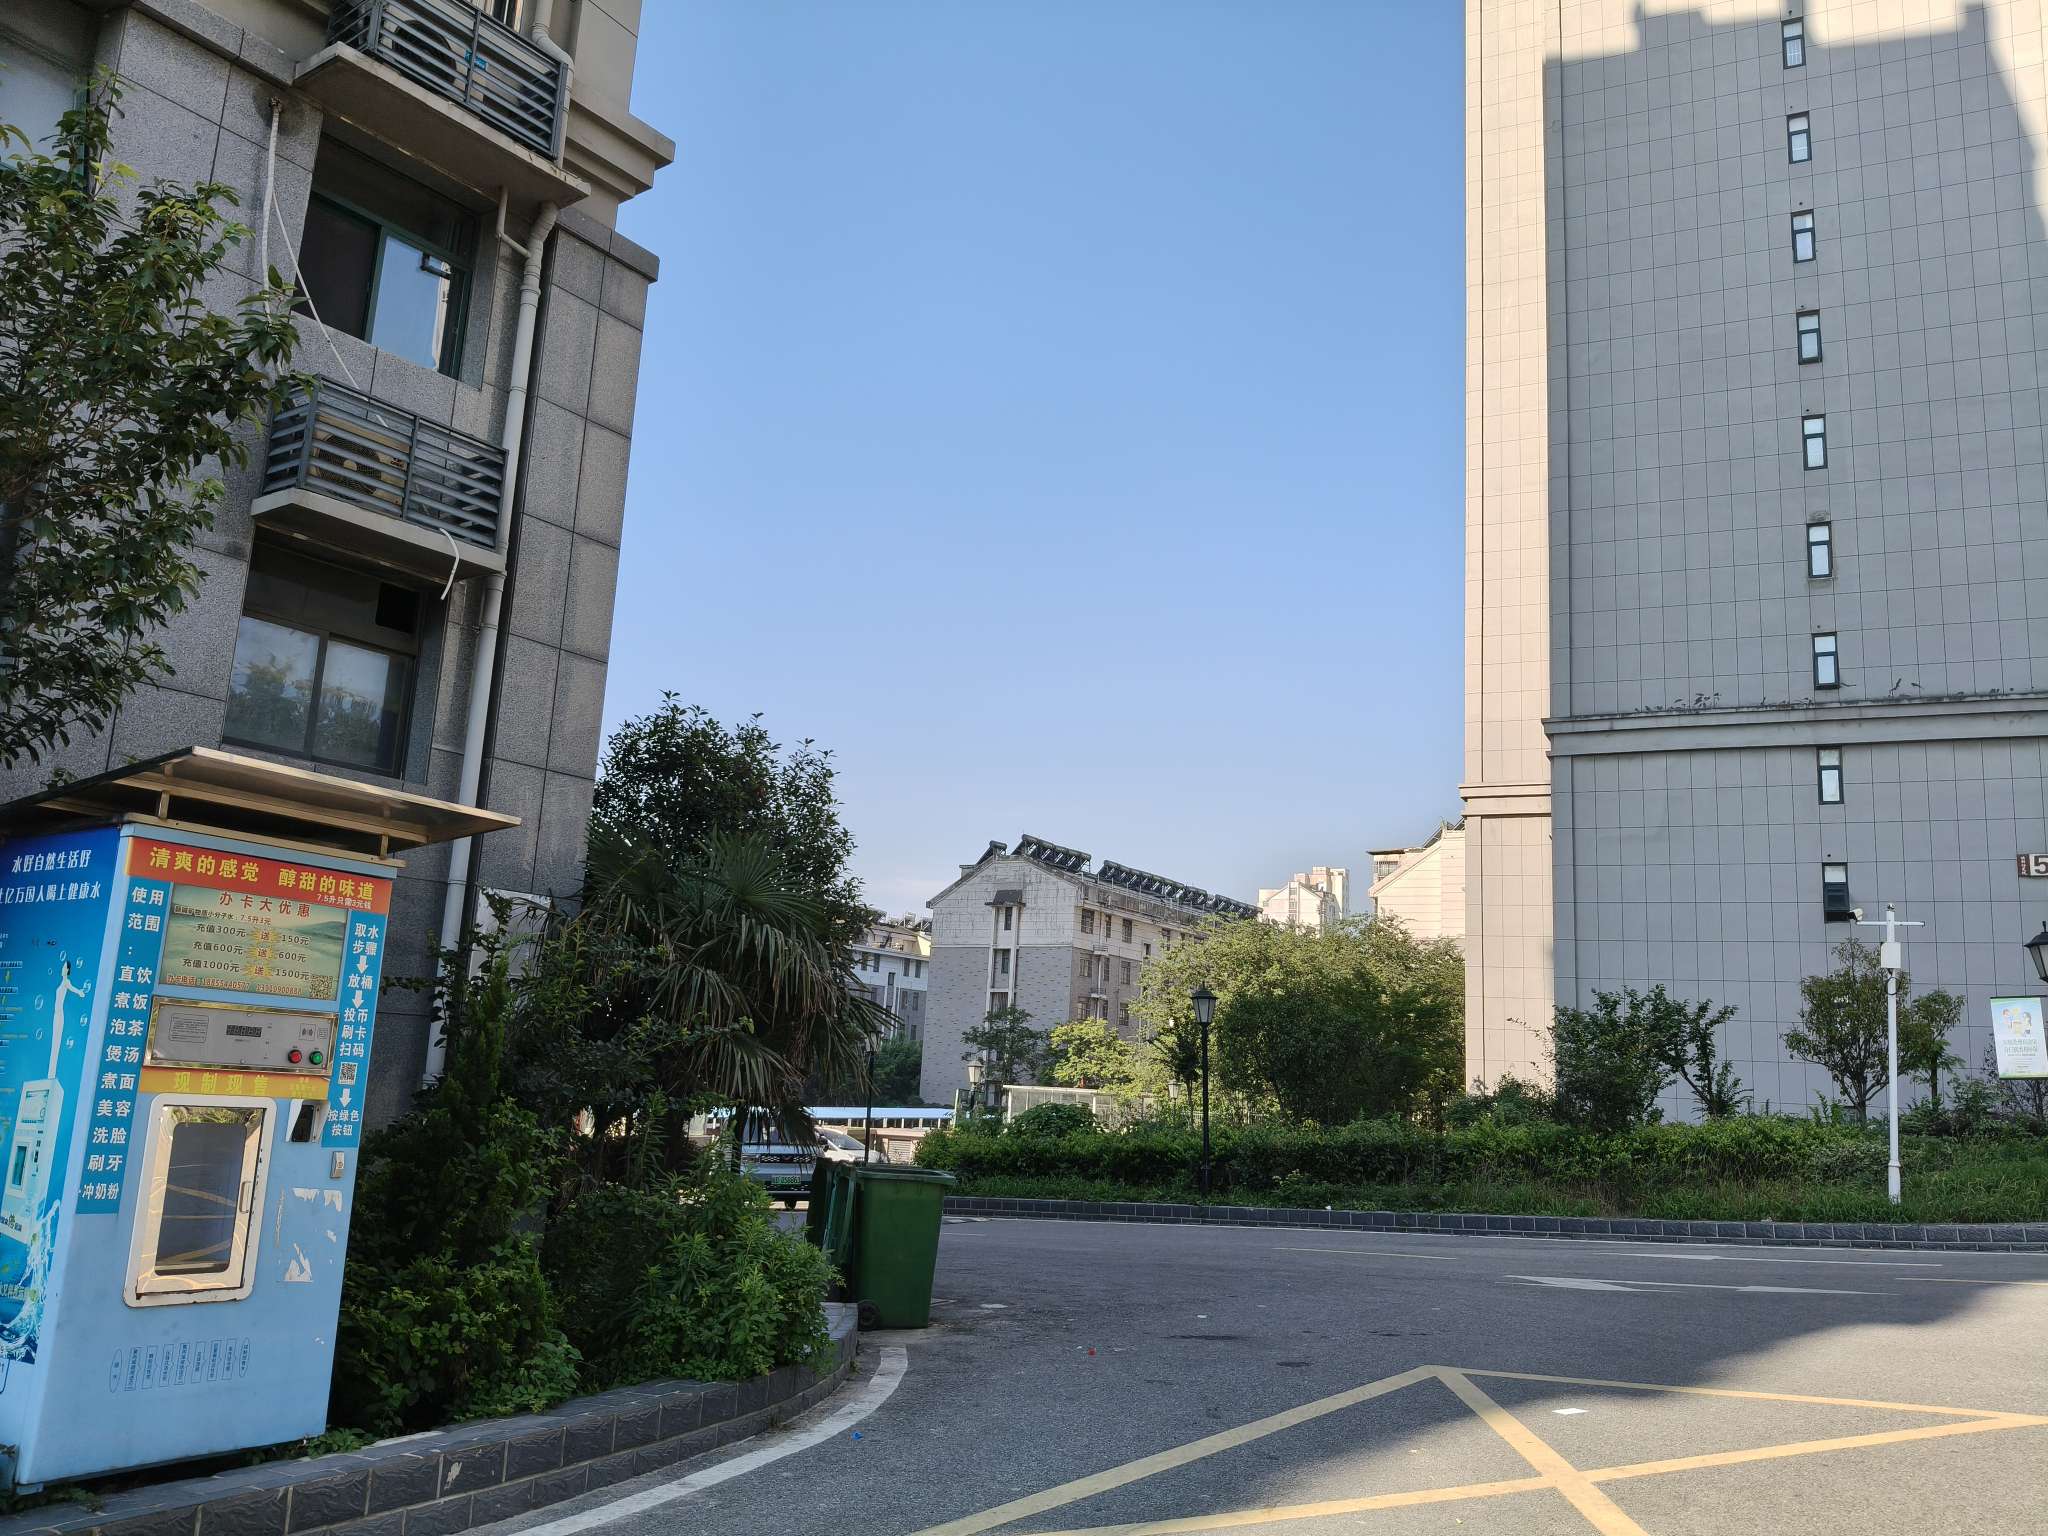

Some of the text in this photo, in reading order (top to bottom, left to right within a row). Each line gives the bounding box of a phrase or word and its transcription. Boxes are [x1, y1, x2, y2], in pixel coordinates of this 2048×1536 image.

[12, 849, 91, 872] 水好自然生活好
[150, 846, 375, 901] 清爽的感觉 醇甜的味道
[132, 886, 164, 906] 使用
[220, 891, 311, 918] 办卡大优惠
[128, 913, 160, 932] 范围
[355, 923, 379, 939] 取水
[196, 923, 246, 938] 充值300元
[281, 934, 310, 946] 150元
[193, 941, 243, 955] 充值600元
[278, 951, 307, 963] 600元
[352, 940, 378, 956] 步骤
[118, 965, 152, 984] 直饮
[182, 958, 241, 973] 充值1000元
[274, 968, 311, 981] 1500元
[347, 973, 373, 989] 放桶
[114, 992, 148, 1010] 煮饭
[344, 1007, 368, 1023] 投币
[110, 1018, 144, 1036] 泡茶
[342, 1025, 367, 1040] 刷卡
[105, 1045, 140, 1063] 煲汤
[340, 1042, 364, 1058] 扫码
[101, 1071, 136, 1090] 煮面
[174, 1071, 269, 1096] 现制现售
[96, 1099, 131, 1117] 美容
[328, 1109, 359, 1122] 按绿色
[93, 1126, 127, 1144] 洗脸
[332, 1123, 353, 1136] 按钮
[88, 1154, 123, 1172] 刷牙
[82, 1182, 119, 1200] 冲奶粉
